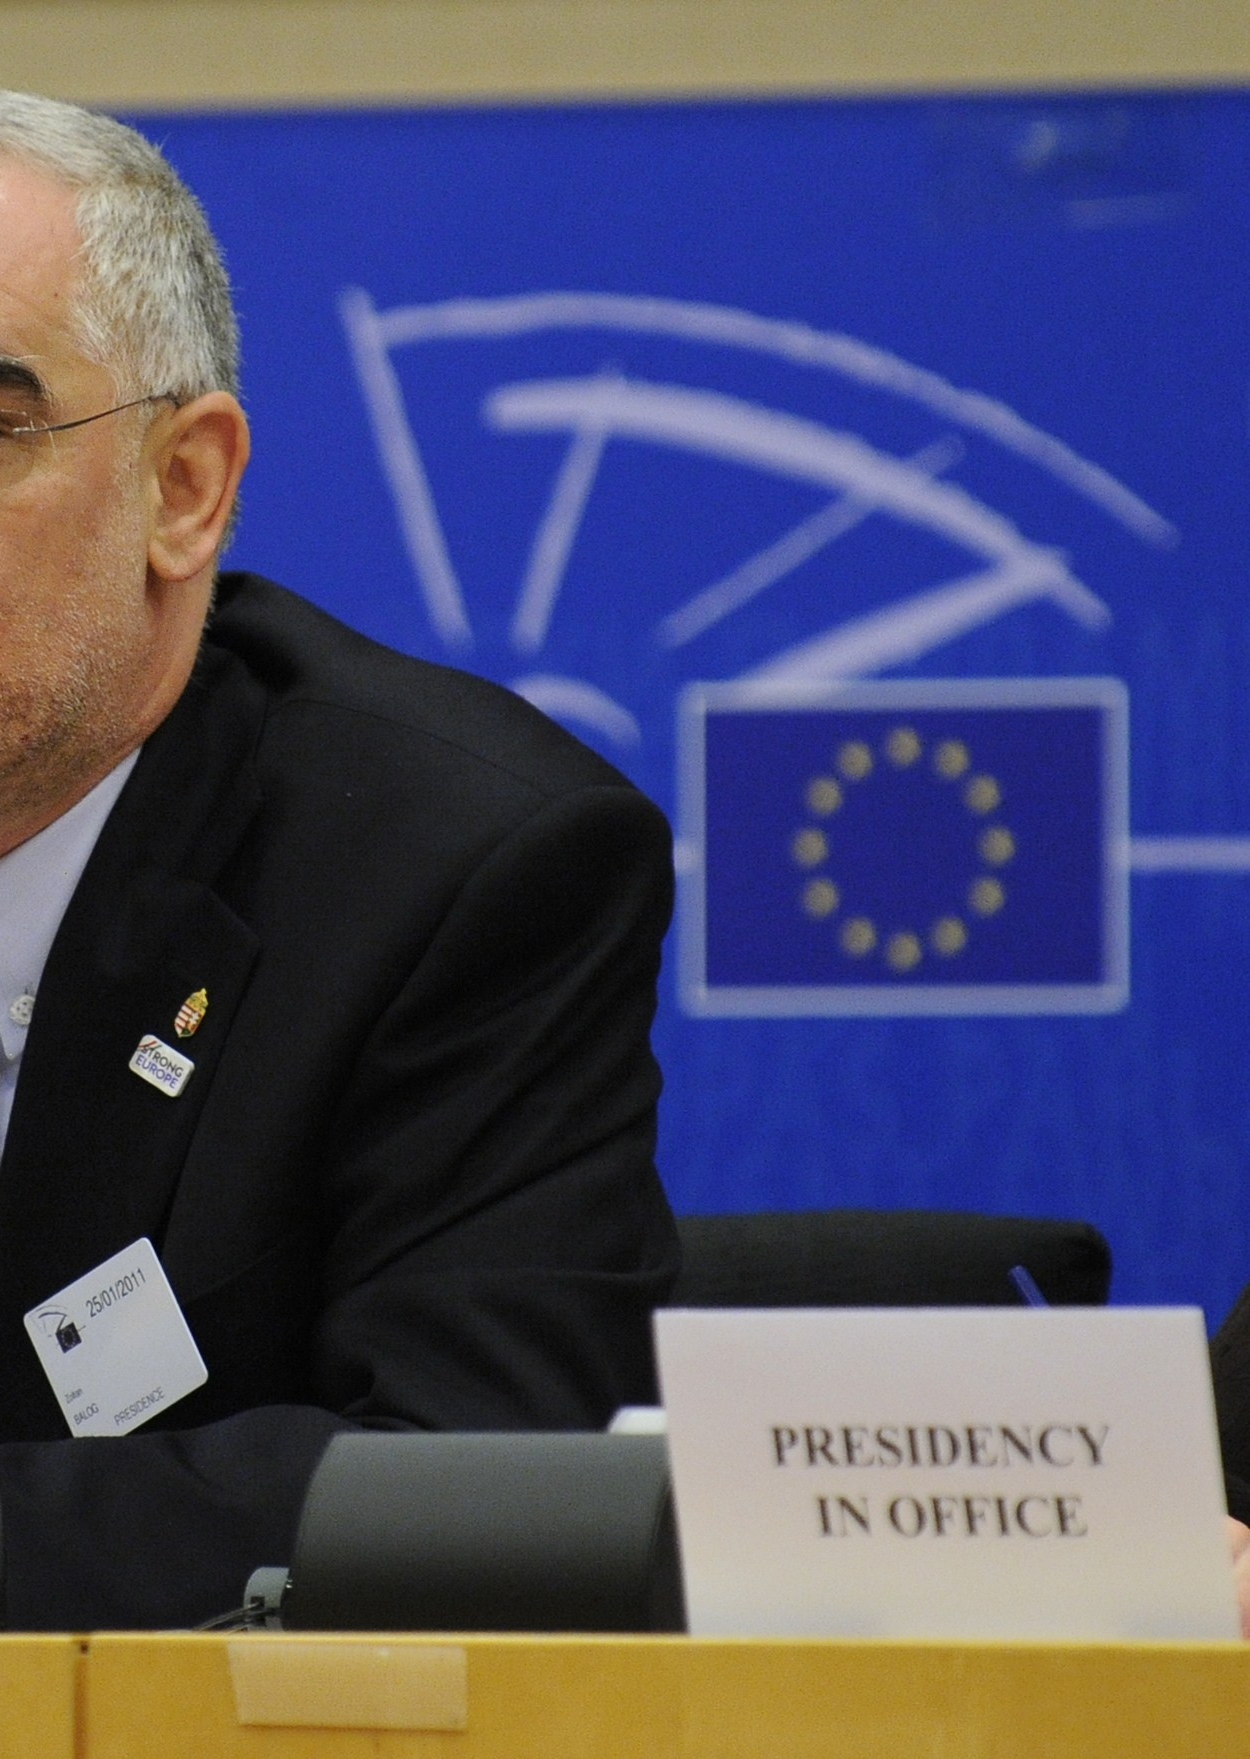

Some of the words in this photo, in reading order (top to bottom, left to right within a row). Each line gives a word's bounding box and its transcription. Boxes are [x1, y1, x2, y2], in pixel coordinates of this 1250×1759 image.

[135, 1054, 178, 1089] EUROPE
[141, 1045, 184, 1078] STRONG
[85, 1268, 146, 1318] 25/01/2011
[73, 1402, 100, 1425] BALOG
[113, 1387, 165, 1426] PRESIDENCE
[770, 1424, 1110, 1468] PRESIDENCY
[816, 1496, 870, 1539] IN
[888, 1495, 1090, 1539] OFFICE
